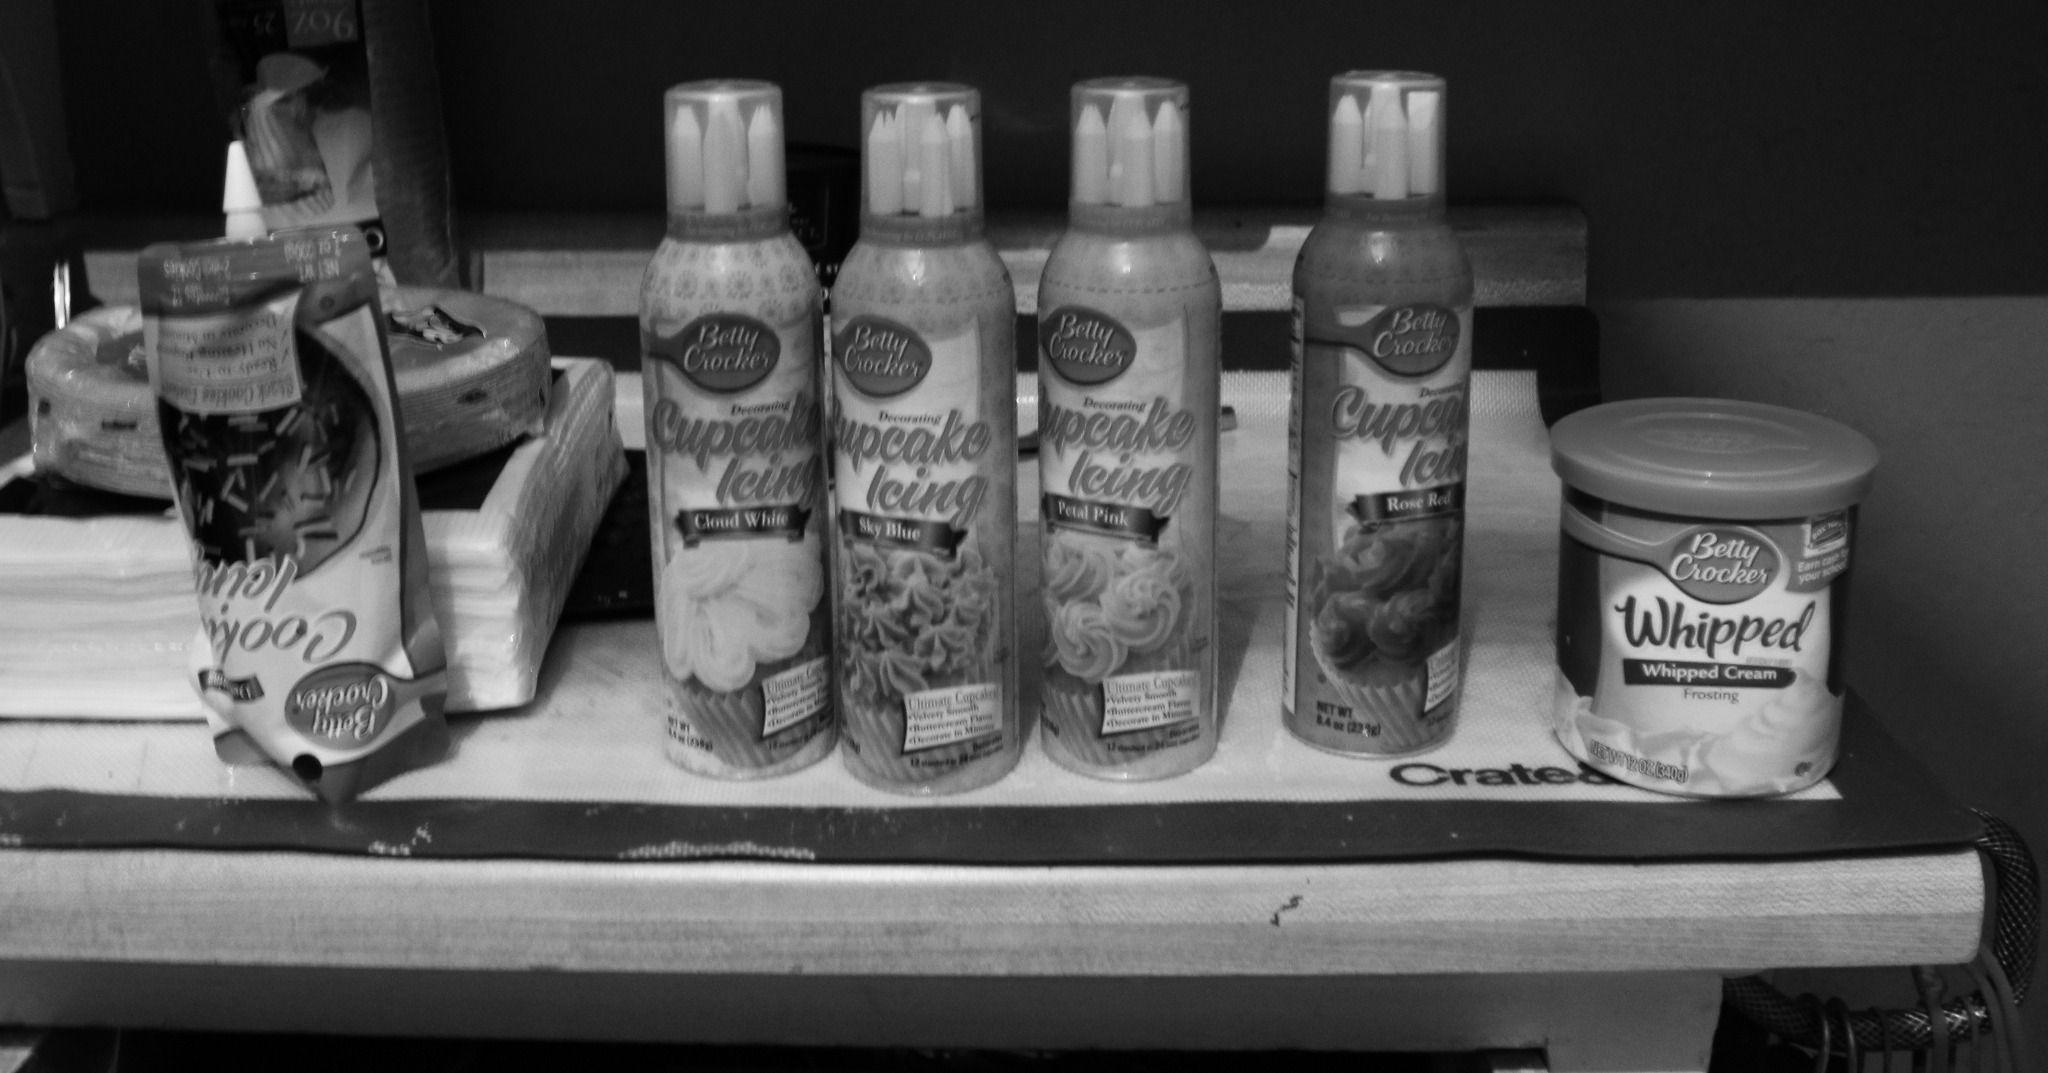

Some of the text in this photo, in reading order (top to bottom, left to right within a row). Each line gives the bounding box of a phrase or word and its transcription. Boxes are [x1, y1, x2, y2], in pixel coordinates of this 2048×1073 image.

[1060, 313, 1116, 347] Betty
[1391, 307, 1449, 336] Betty
[699, 323, 760, 350] Betty
[855, 323, 910, 354] Betty
[1049, 330, 1125, 366] Crocker
[683, 343, 769, 372] Crocker
[844, 345, 920, 377] Crocker
[879, 410, 942, 426] Decorating
[1083, 397, 1147, 413] Decorating
[1039, 386, 1196, 461] upcake
[833, 401, 992, 475] upcake
[866, 464, 989, 529] Icing
[1068, 450, 1194, 518] Icing
[1058, 500, 1129, 526] Petal Pink
[1387, 496, 1424, 512] Rose
[694, 511, 790, 530] Cloud White
[859, 517, 921, 542] Sky Blue
[1691, 532, 1760, 566] Betty
[1669, 553, 1770, 584] Crocker
[1798, 559, 1821, 573] Earn
[1799, 570, 1822, 586] your
[1614, 595, 1817, 659] Whipped
[1642, 663, 1777, 682] Whipped Cream
[295, 673, 389, 713] Crocker
[1107, 681, 1149, 694] Ultimate
[1110, 694, 1141, 704] Velvety
[1683, 688, 1740, 703] Frosting
[908, 696, 951, 711] Ultimate
[1316, 700, 1352, 719] NET WT
[312, 704, 376, 743] Betty
[1110, 716, 1149, 727] Decorate
[1316, 713, 1331, 728] 8.4
[1332, 720, 1344, 731] oz
[1655, 761, 1689, 784] (340g)
